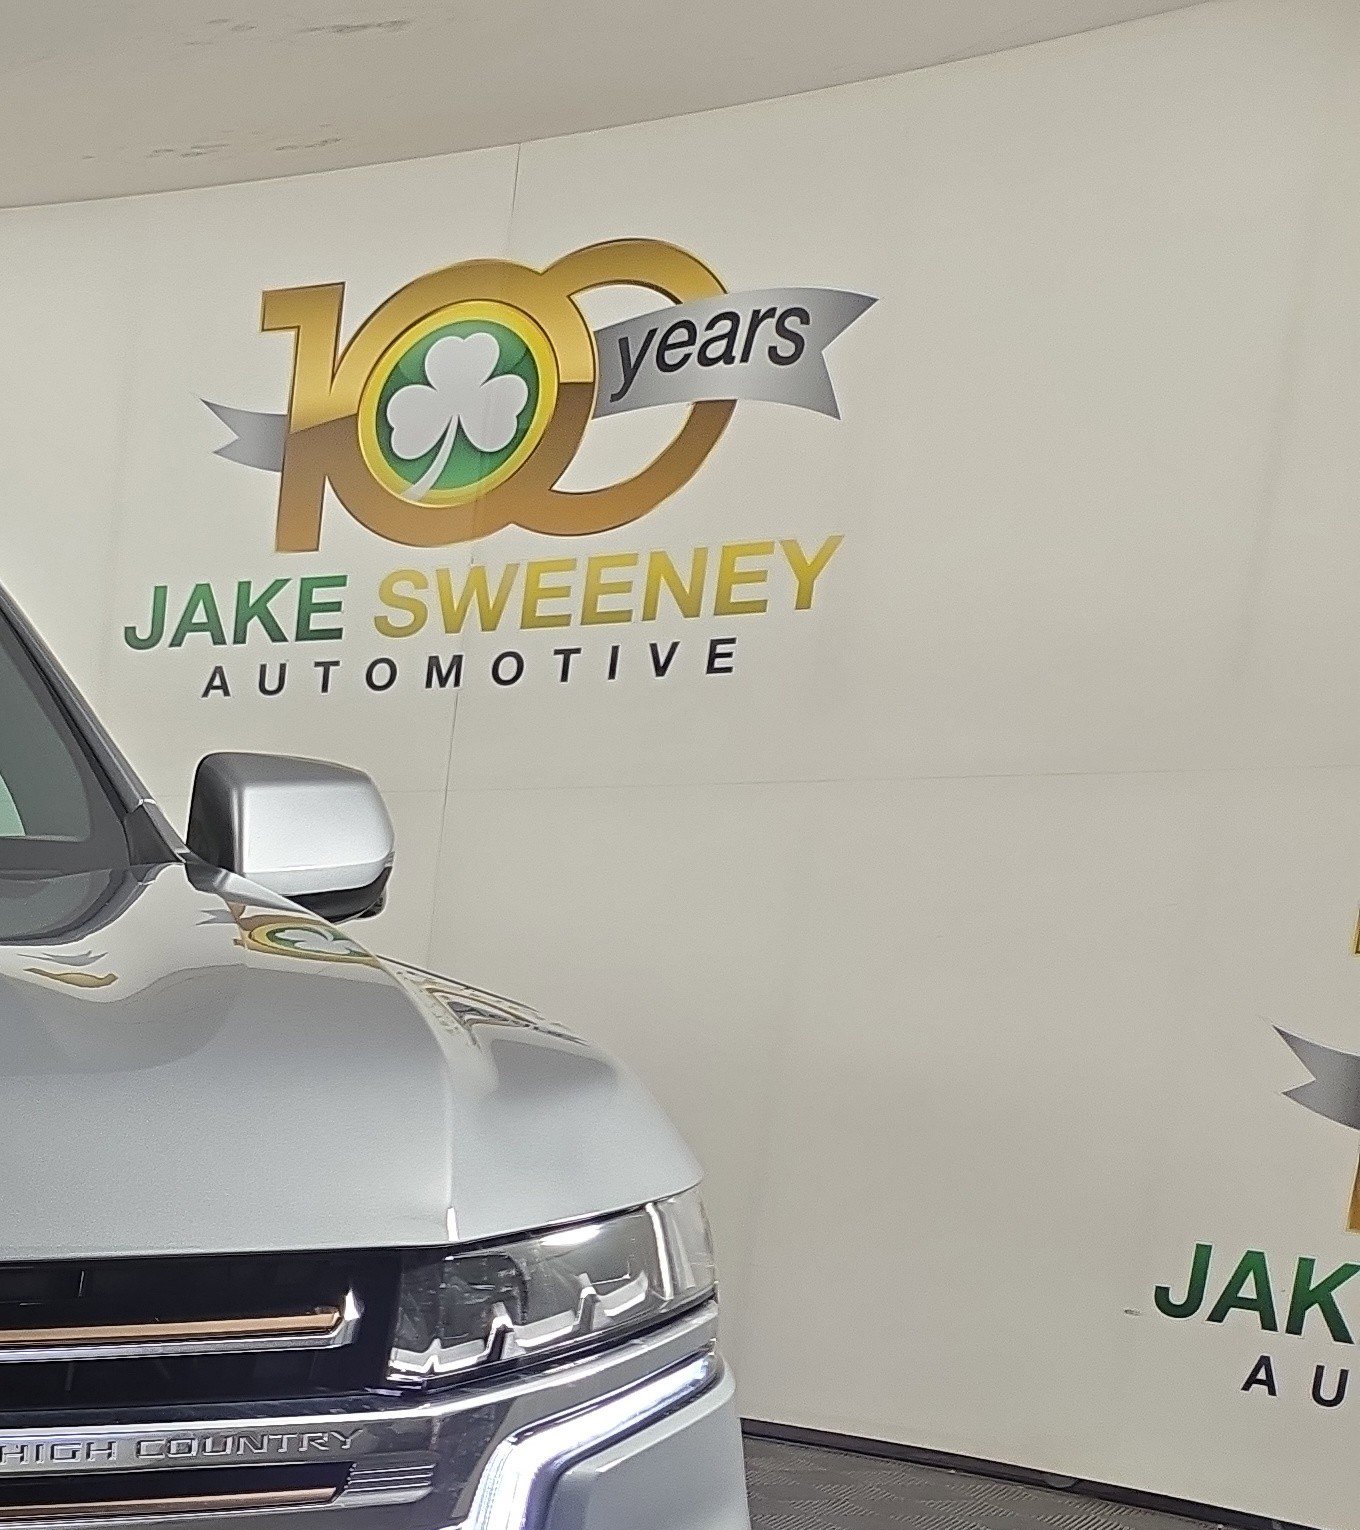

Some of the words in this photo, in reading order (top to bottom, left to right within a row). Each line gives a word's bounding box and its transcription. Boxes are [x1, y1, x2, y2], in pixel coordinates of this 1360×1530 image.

[261, 237, 736, 553] 100
[610, 304, 810, 402] years
[123, 574, 349, 652] JAKE
[373, 534, 845, 639] SWEENEY
[201, 638, 738, 700] AUTOMOTIVE
[1153, 1241, 1360, 1346] JAK
[135, 1428, 364, 1461] COUNTRY
